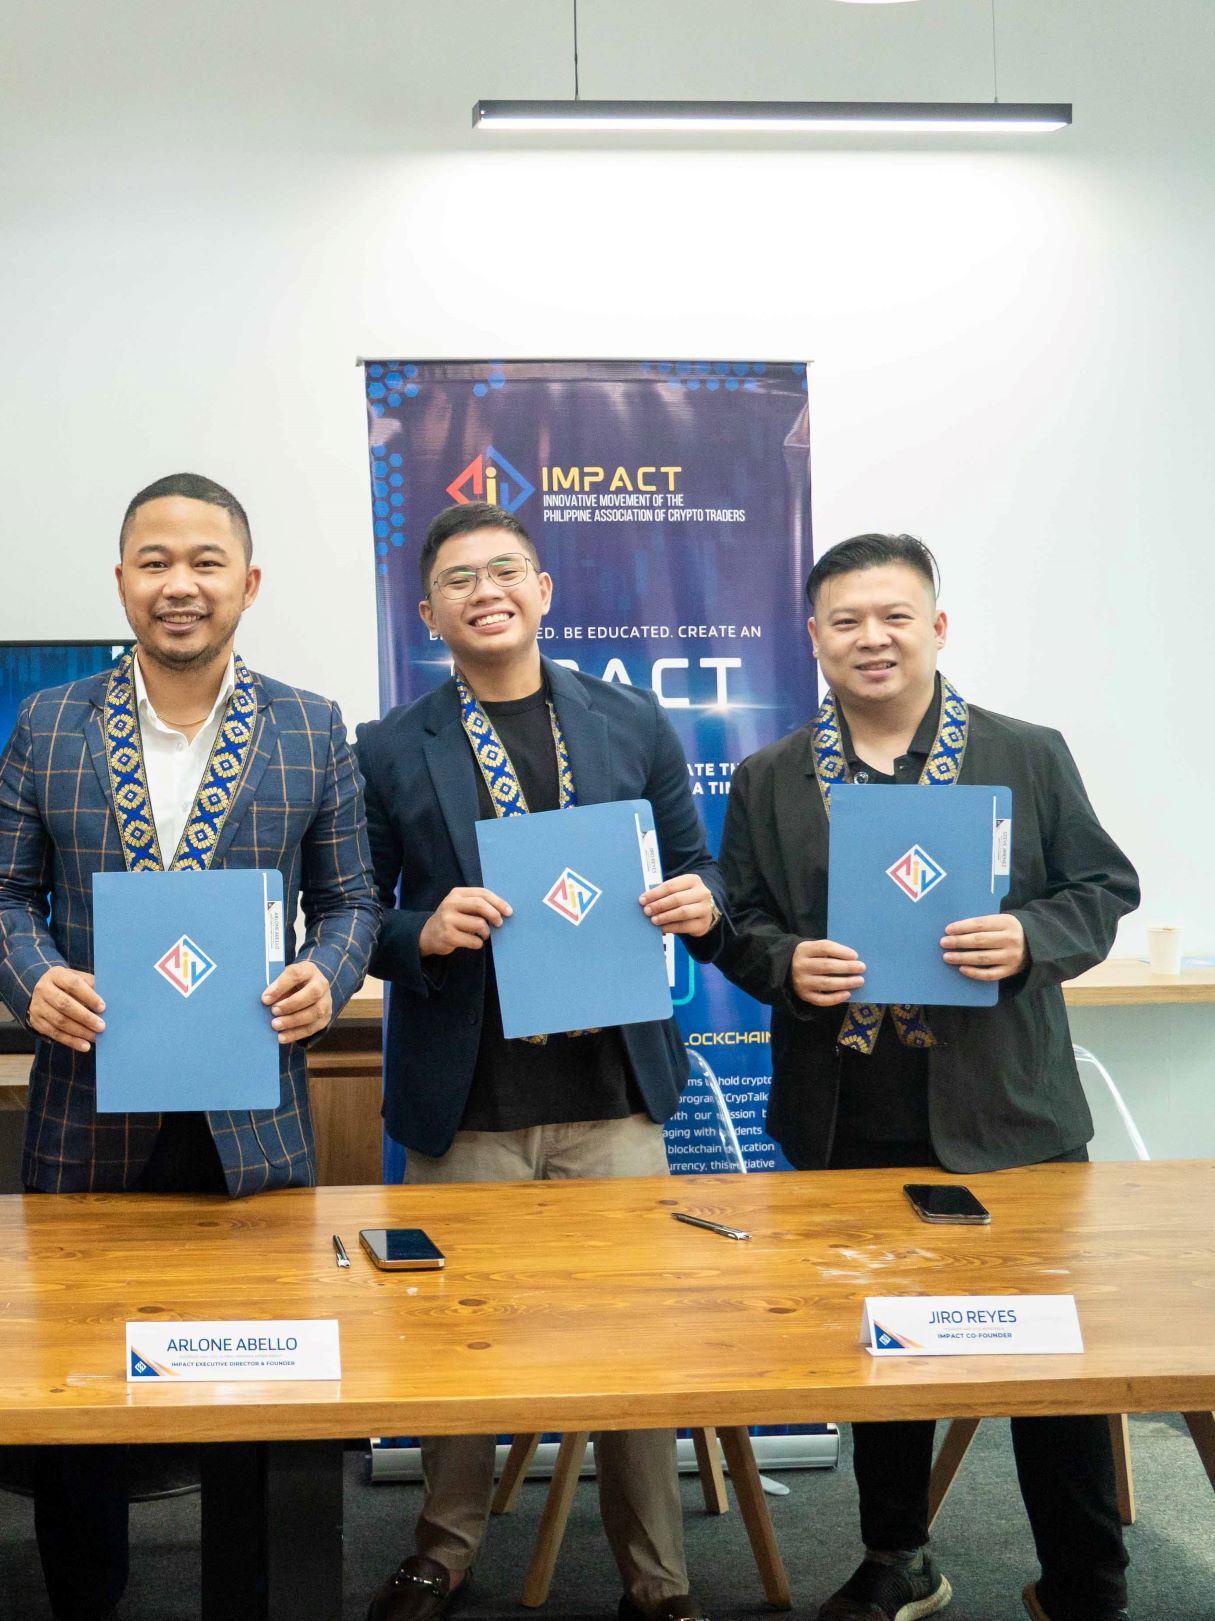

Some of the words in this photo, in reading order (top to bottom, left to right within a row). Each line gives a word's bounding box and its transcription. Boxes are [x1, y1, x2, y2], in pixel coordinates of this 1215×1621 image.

[542, 466, 683, 492] IMPACT
[543, 494, 598, 507] INNOVATIVE
[599, 493, 652, 507] MOVEMENT
[653, 493, 664, 507] OF
[665, 493, 685, 507] THE
[543, 509, 592, 523] PHILIPPINE
[593, 508, 653, 522] ASSOCIATION
[654, 508, 666, 522] OF
[668, 508, 704, 522] CRYPTO
[705, 509, 747, 523] TRADERS
[535, 626, 559, 640] ED.
[564, 626, 583, 640] BE
[587, 625, 673, 640] EDUCATED.
[677, 625, 736, 639] CREATE
[740, 624, 762, 638] AN
[692, 781, 704, 795] A
[694, 1111, 712, 1120] our
[693, 1127, 716, 1137] with
[667, 1144, 722, 1154] blockchain
[710, 1160, 730, 1170] this
[929, 1310, 964, 1324] JIRO
[967, 1309, 1018, 1323] REYES
[167, 1338, 233, 1352] ARLONE
[236, 1337, 298, 1351] ABELLO
